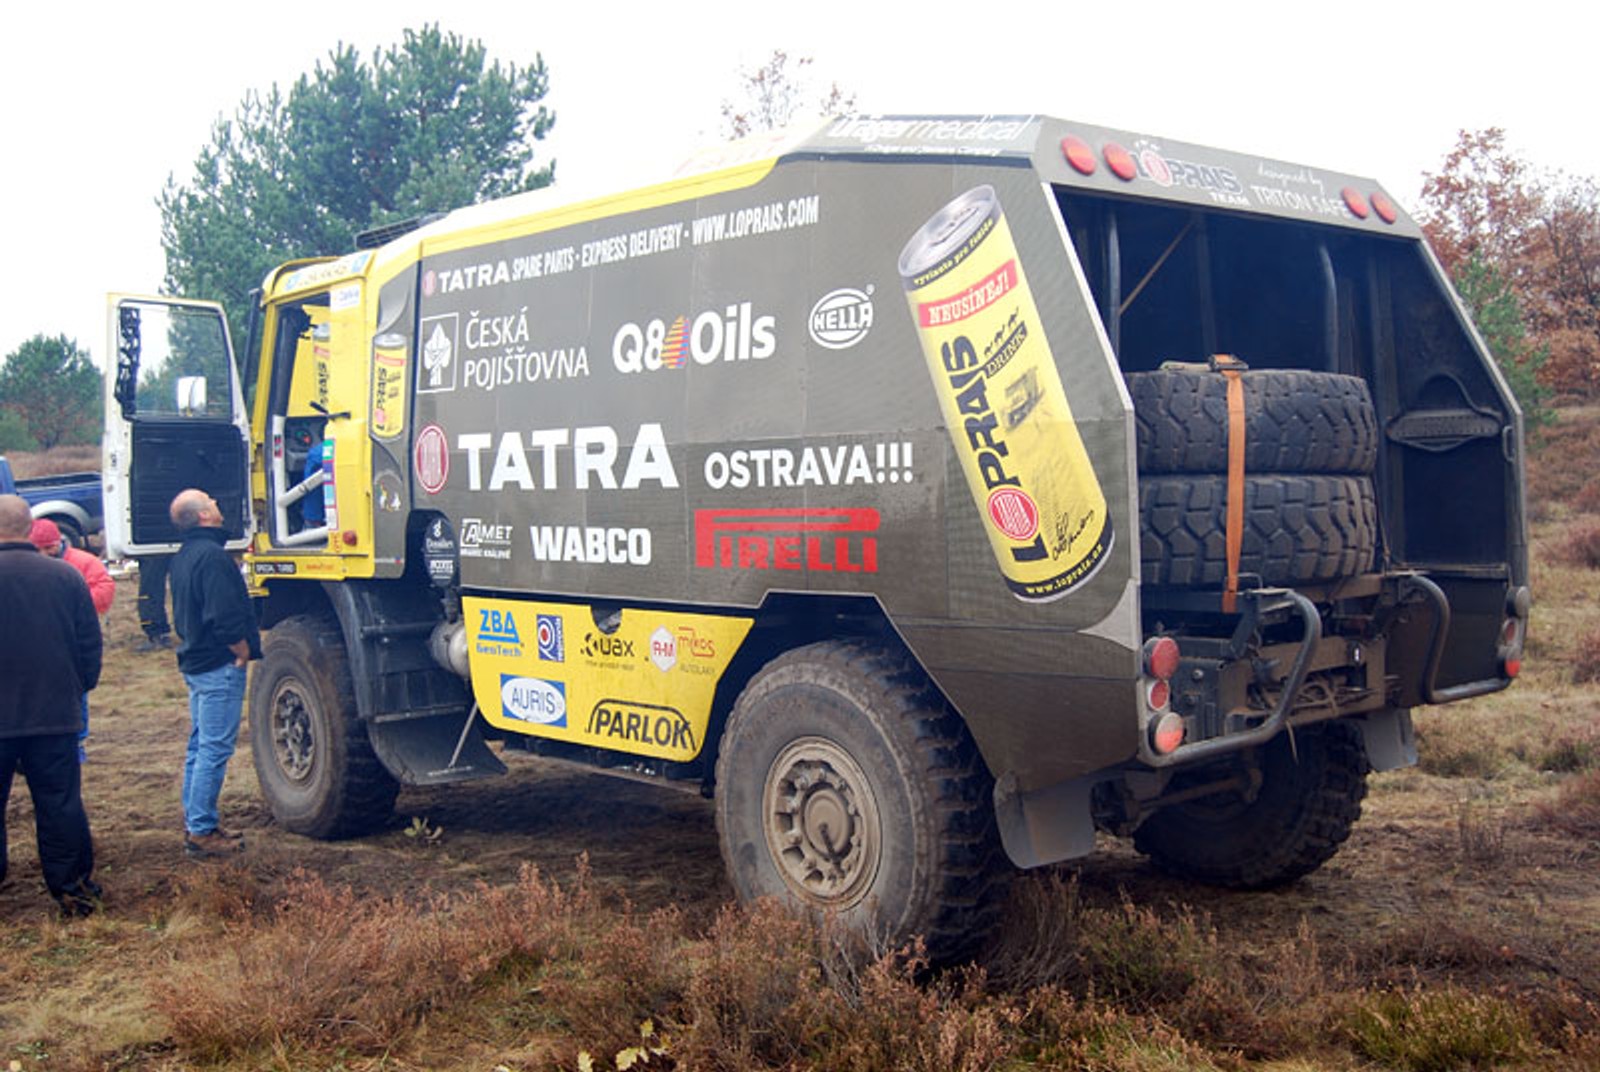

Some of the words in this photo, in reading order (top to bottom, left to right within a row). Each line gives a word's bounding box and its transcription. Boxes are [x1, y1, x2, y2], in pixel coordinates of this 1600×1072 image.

[1250, 184, 1312, 211] TRITON
[438, 260, 511, 294] TATRA
[512, 254, 544, 281] SPARE
[544, 246, 574, 276] PARTS
[581, 234, 628, 267] EXPRESS
[629, 222, 684, 258] DELIVERY
[691, 195, 820, 245] WWW.LOPRAIS.COM
[464, 305, 530, 350] ČESKÁ
[612, 318, 665, 375] Q8
[690, 302, 777, 366] Oils
[813, 301, 873, 331] HELLA
[463, 346, 590, 393] POJIŠŤOVNA
[457, 423, 680, 492] TATRA
[703, 441, 914, 490] OSTRAVA!!!
[530, 524, 652, 565] WABCO
[694, 507, 881, 573] PIRELLI
[478, 609, 520, 636] ZBA
[511, 687, 556, 715] AURIS
[594, 708, 688, 750] PARLOK
